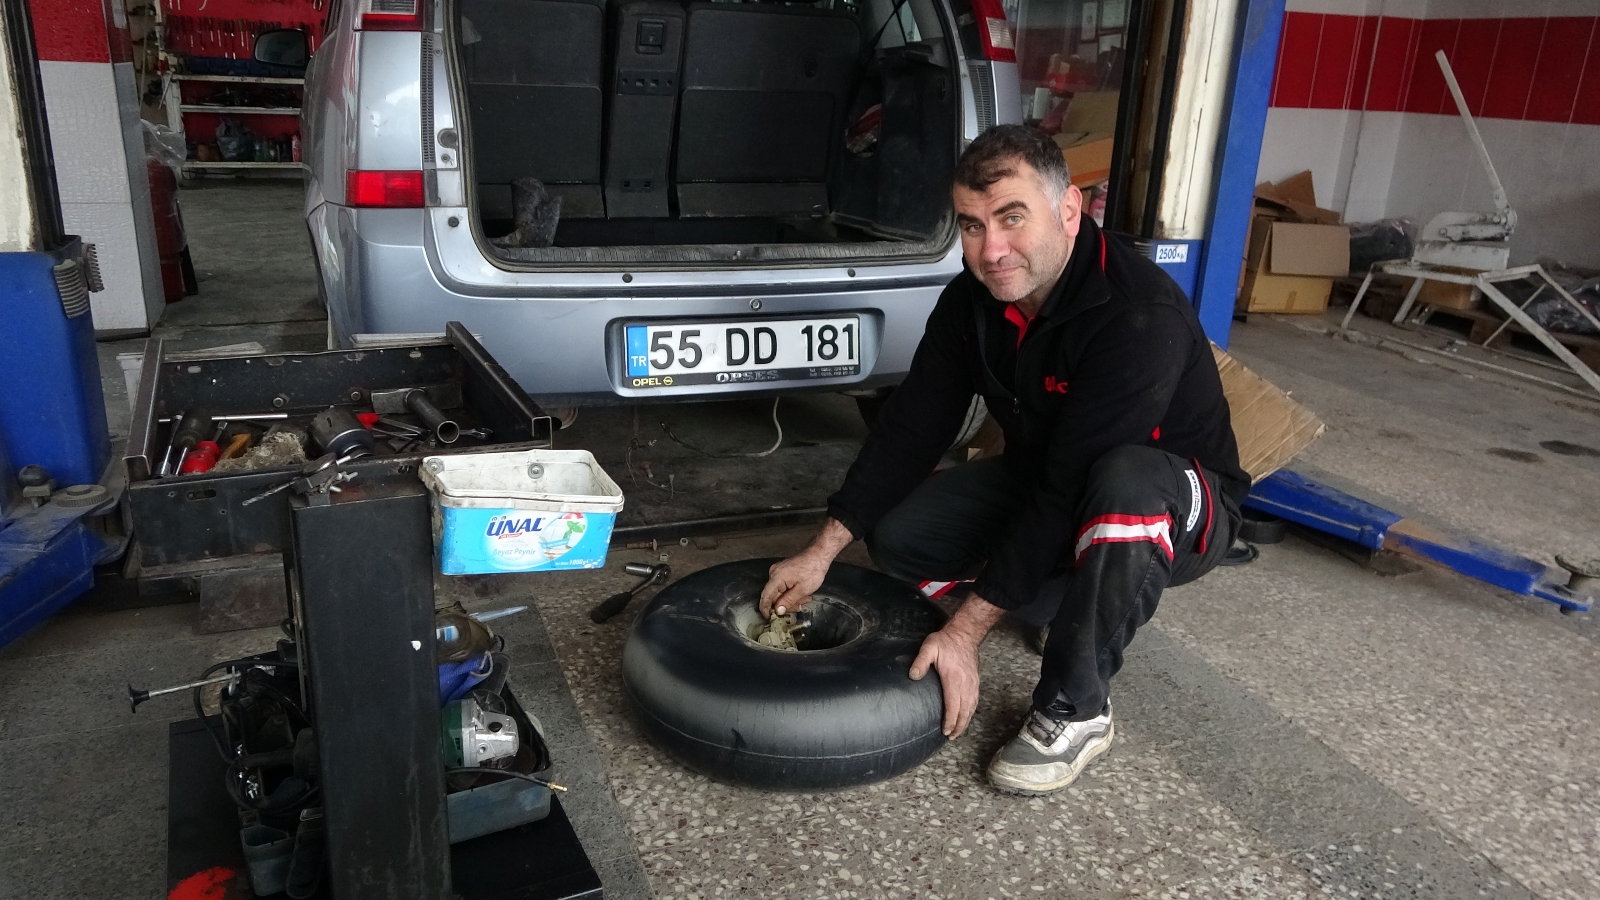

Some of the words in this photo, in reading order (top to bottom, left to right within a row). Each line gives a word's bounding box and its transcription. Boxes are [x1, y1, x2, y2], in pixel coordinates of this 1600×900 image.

[1159, 248, 1177, 259] 2500
[650, 329, 703, 369] 55
[725, 327, 778, 366] DD
[801, 324, 854, 362] 181
[631, 356, 647, 367] TR
[715, 369, 779, 383] OPSES
[632, 377, 662, 387] OPEL
[486, 515, 543, 537] ÜNAL
[492, 548, 514, 557] Beyaz
[514, 547, 536, 556] Peynir
